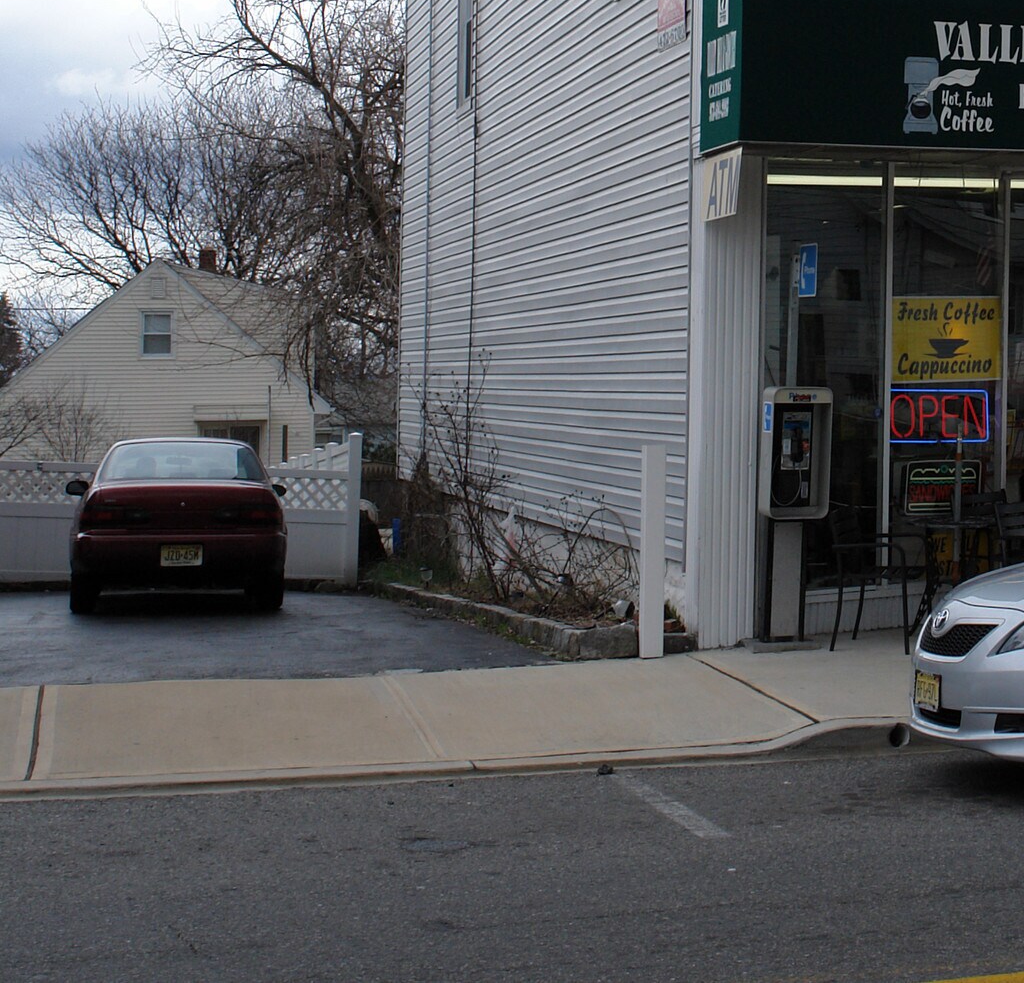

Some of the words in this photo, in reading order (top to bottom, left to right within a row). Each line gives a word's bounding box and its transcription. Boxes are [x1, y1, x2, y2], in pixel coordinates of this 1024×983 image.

[966, 90, 994, 107] Fresh
[940, 105, 995, 133] Coffee
[706, 154, 741, 219] ATM
[897, 301, 938, 321] Fresh
[943, 301, 995, 325] Coffee
[897, 352, 992, 380] Cappuccino
[890, 394, 986, 438] OPEN
